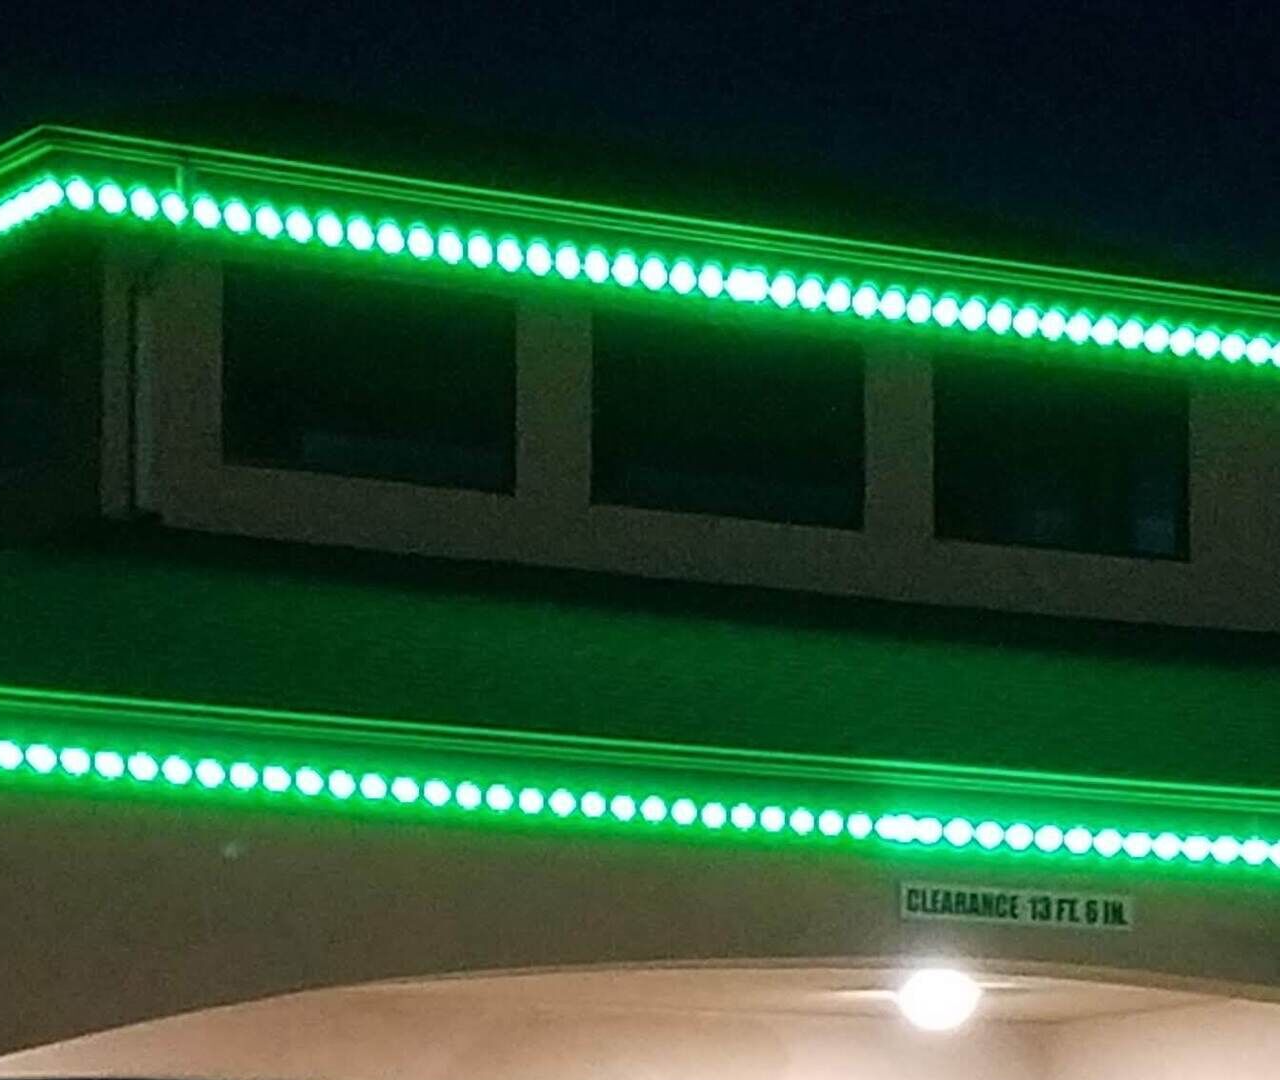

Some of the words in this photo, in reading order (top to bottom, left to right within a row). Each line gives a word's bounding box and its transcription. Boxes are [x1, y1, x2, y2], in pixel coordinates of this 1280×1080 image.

[907, 889, 1018, 920] CLEARANCE
[1028, 897, 1052, 920] 13
[1085, 900, 1098, 923] 6
